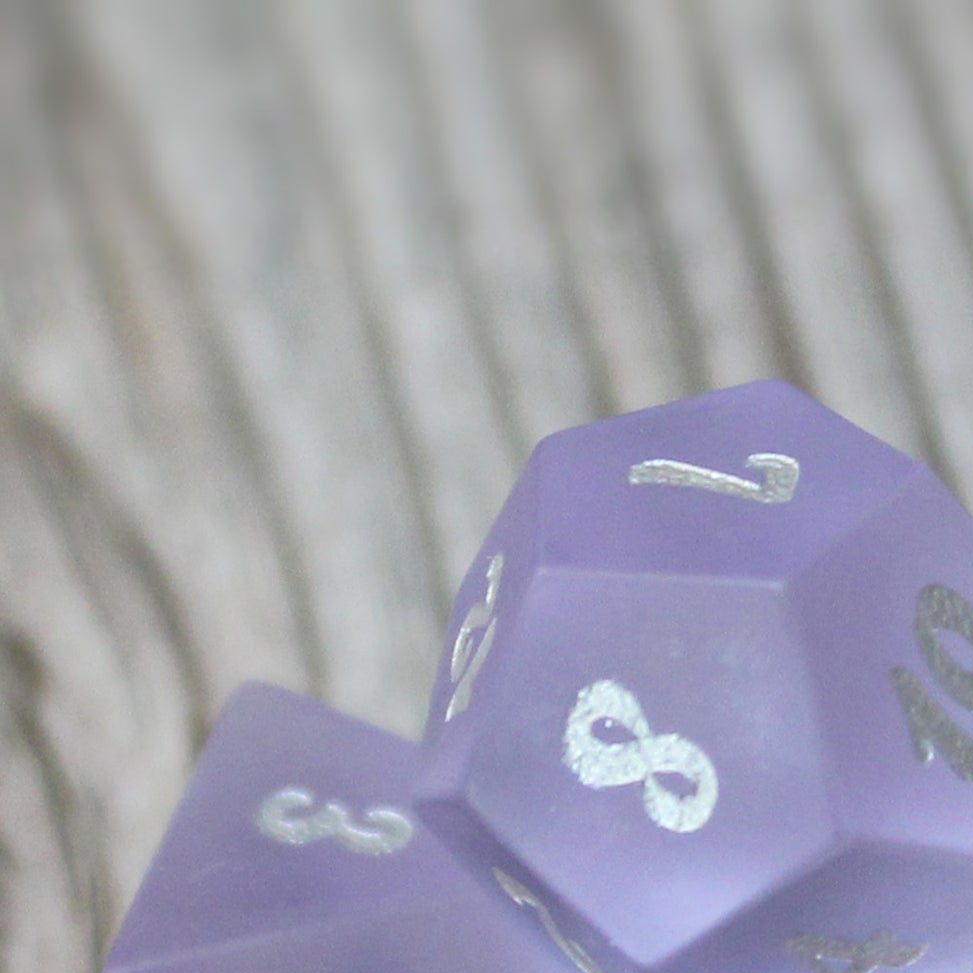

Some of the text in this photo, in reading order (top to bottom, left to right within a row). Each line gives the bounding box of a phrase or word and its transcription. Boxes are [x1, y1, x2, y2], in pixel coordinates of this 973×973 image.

[628, 453, 800, 502] 7
[564, 679, 718, 834] 8
[257, 787, 414, 855] 3
